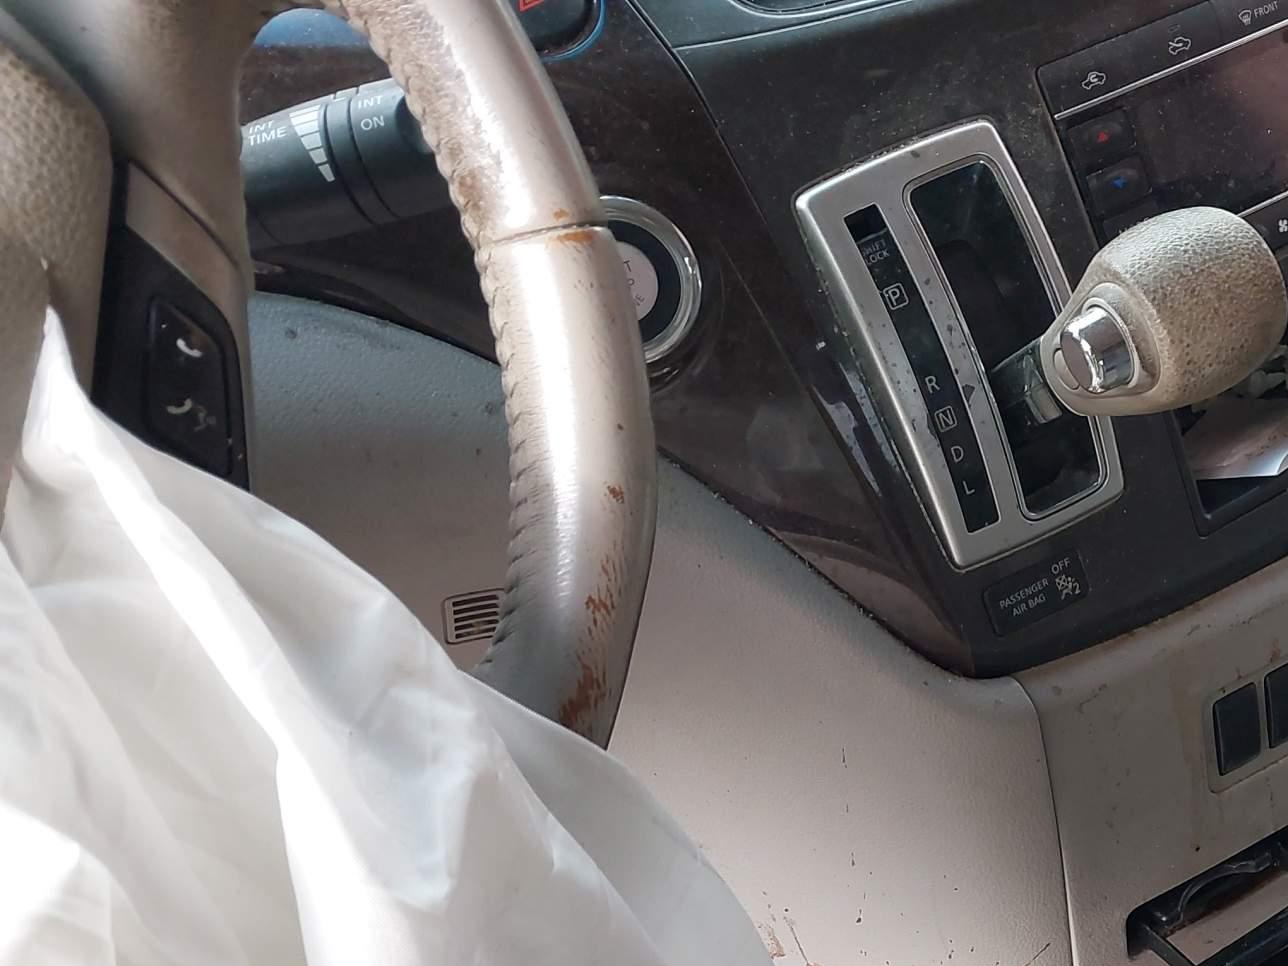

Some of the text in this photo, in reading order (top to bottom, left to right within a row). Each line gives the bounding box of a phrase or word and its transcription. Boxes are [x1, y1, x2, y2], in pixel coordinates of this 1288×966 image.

[1253, 1, 1278, 18] FRONT
[358, 96, 383, 110] INT
[249, 120, 274, 134] INT
[361, 115, 385, 131] ON
[248, 126, 288, 146] TIME
[888, 288, 900, 306] P
[925, 375, 940, 394] R
[938, 409, 954, 429] N
[951, 445, 964, 463] D
[963, 480, 976, 495] L
[1051, 557, 1071, 574] OFF
[999, 578, 1049, 609] PASSENGER
[1012, 593, 1046, 617] AIR BAG
